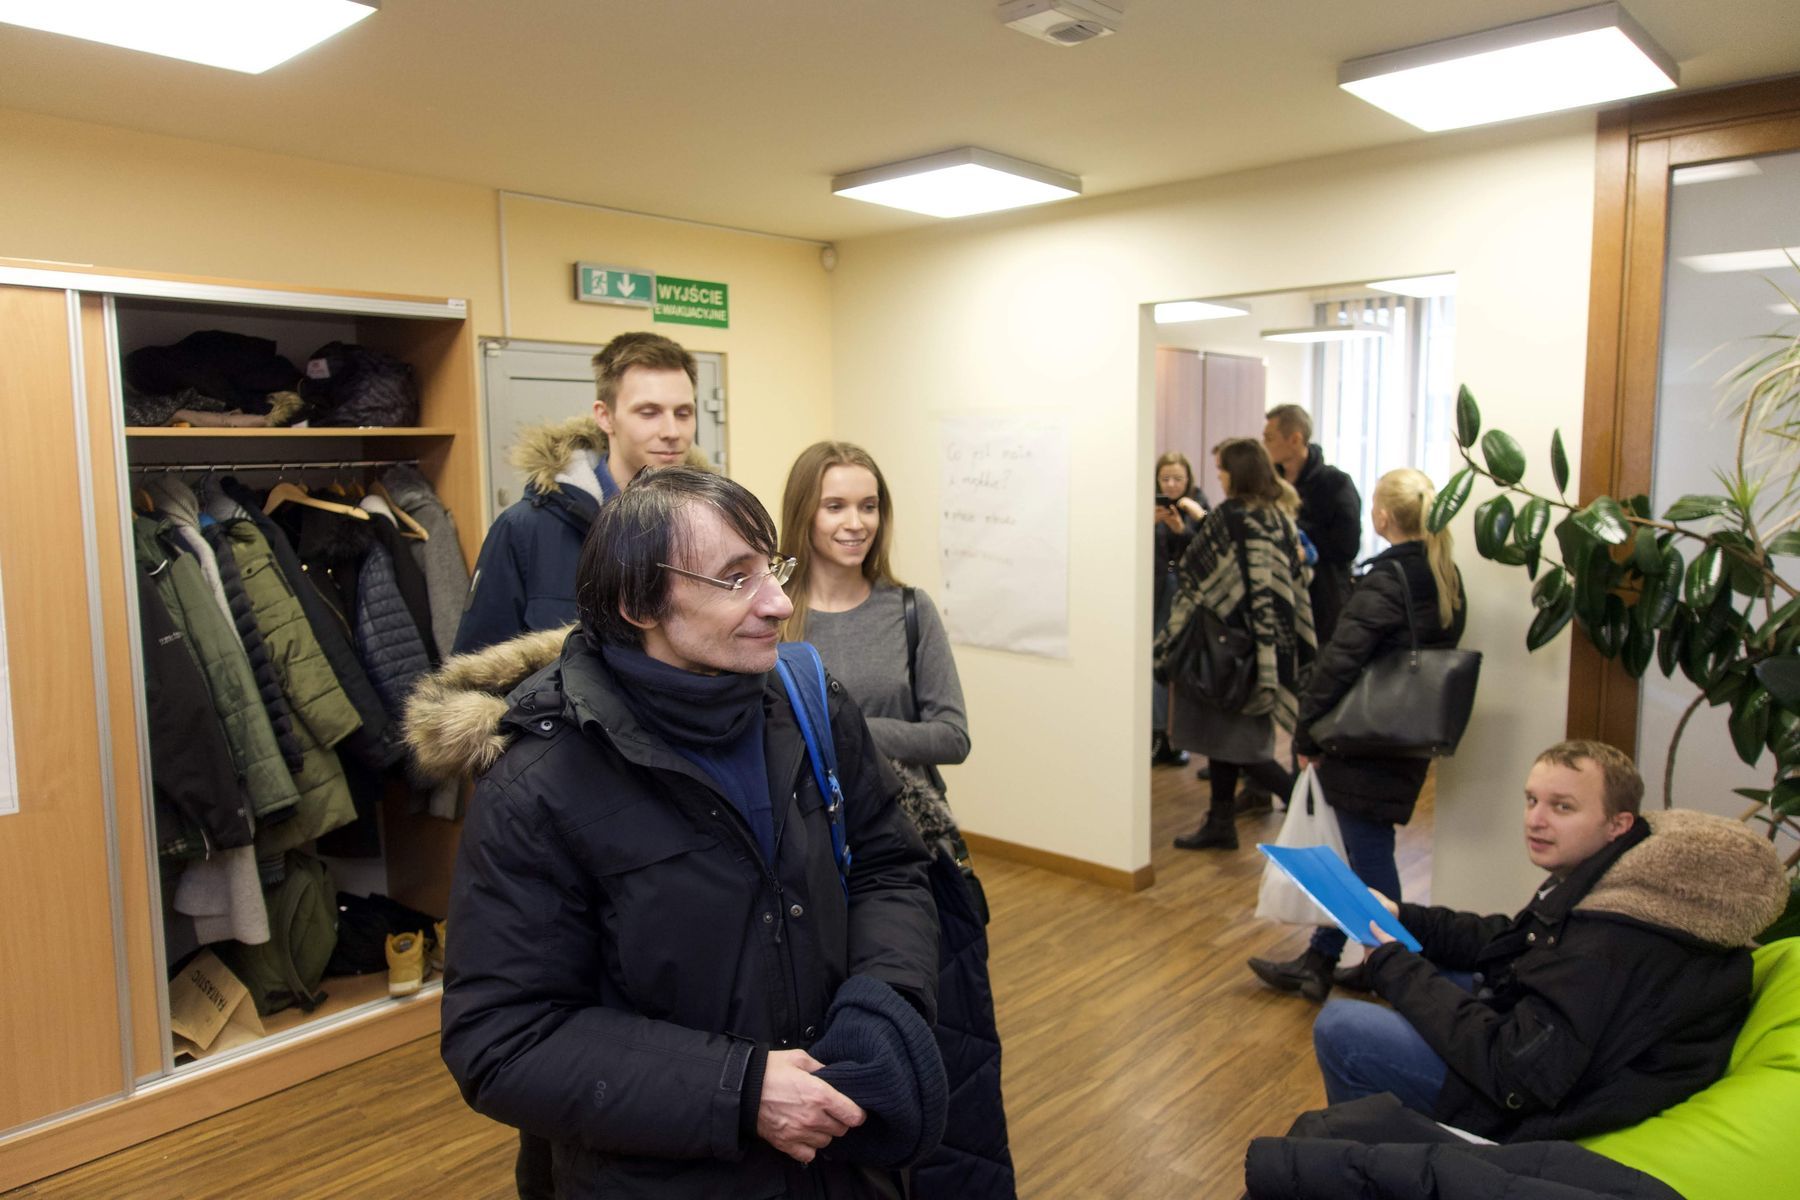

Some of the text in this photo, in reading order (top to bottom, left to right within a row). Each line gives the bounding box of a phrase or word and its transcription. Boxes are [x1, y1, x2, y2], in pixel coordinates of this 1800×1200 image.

[657, 284, 723, 305] WYJŚCIE
[655, 303, 727, 321] EWAKUACYJNE
[192, 970, 227, 1012] FANTASTIC
